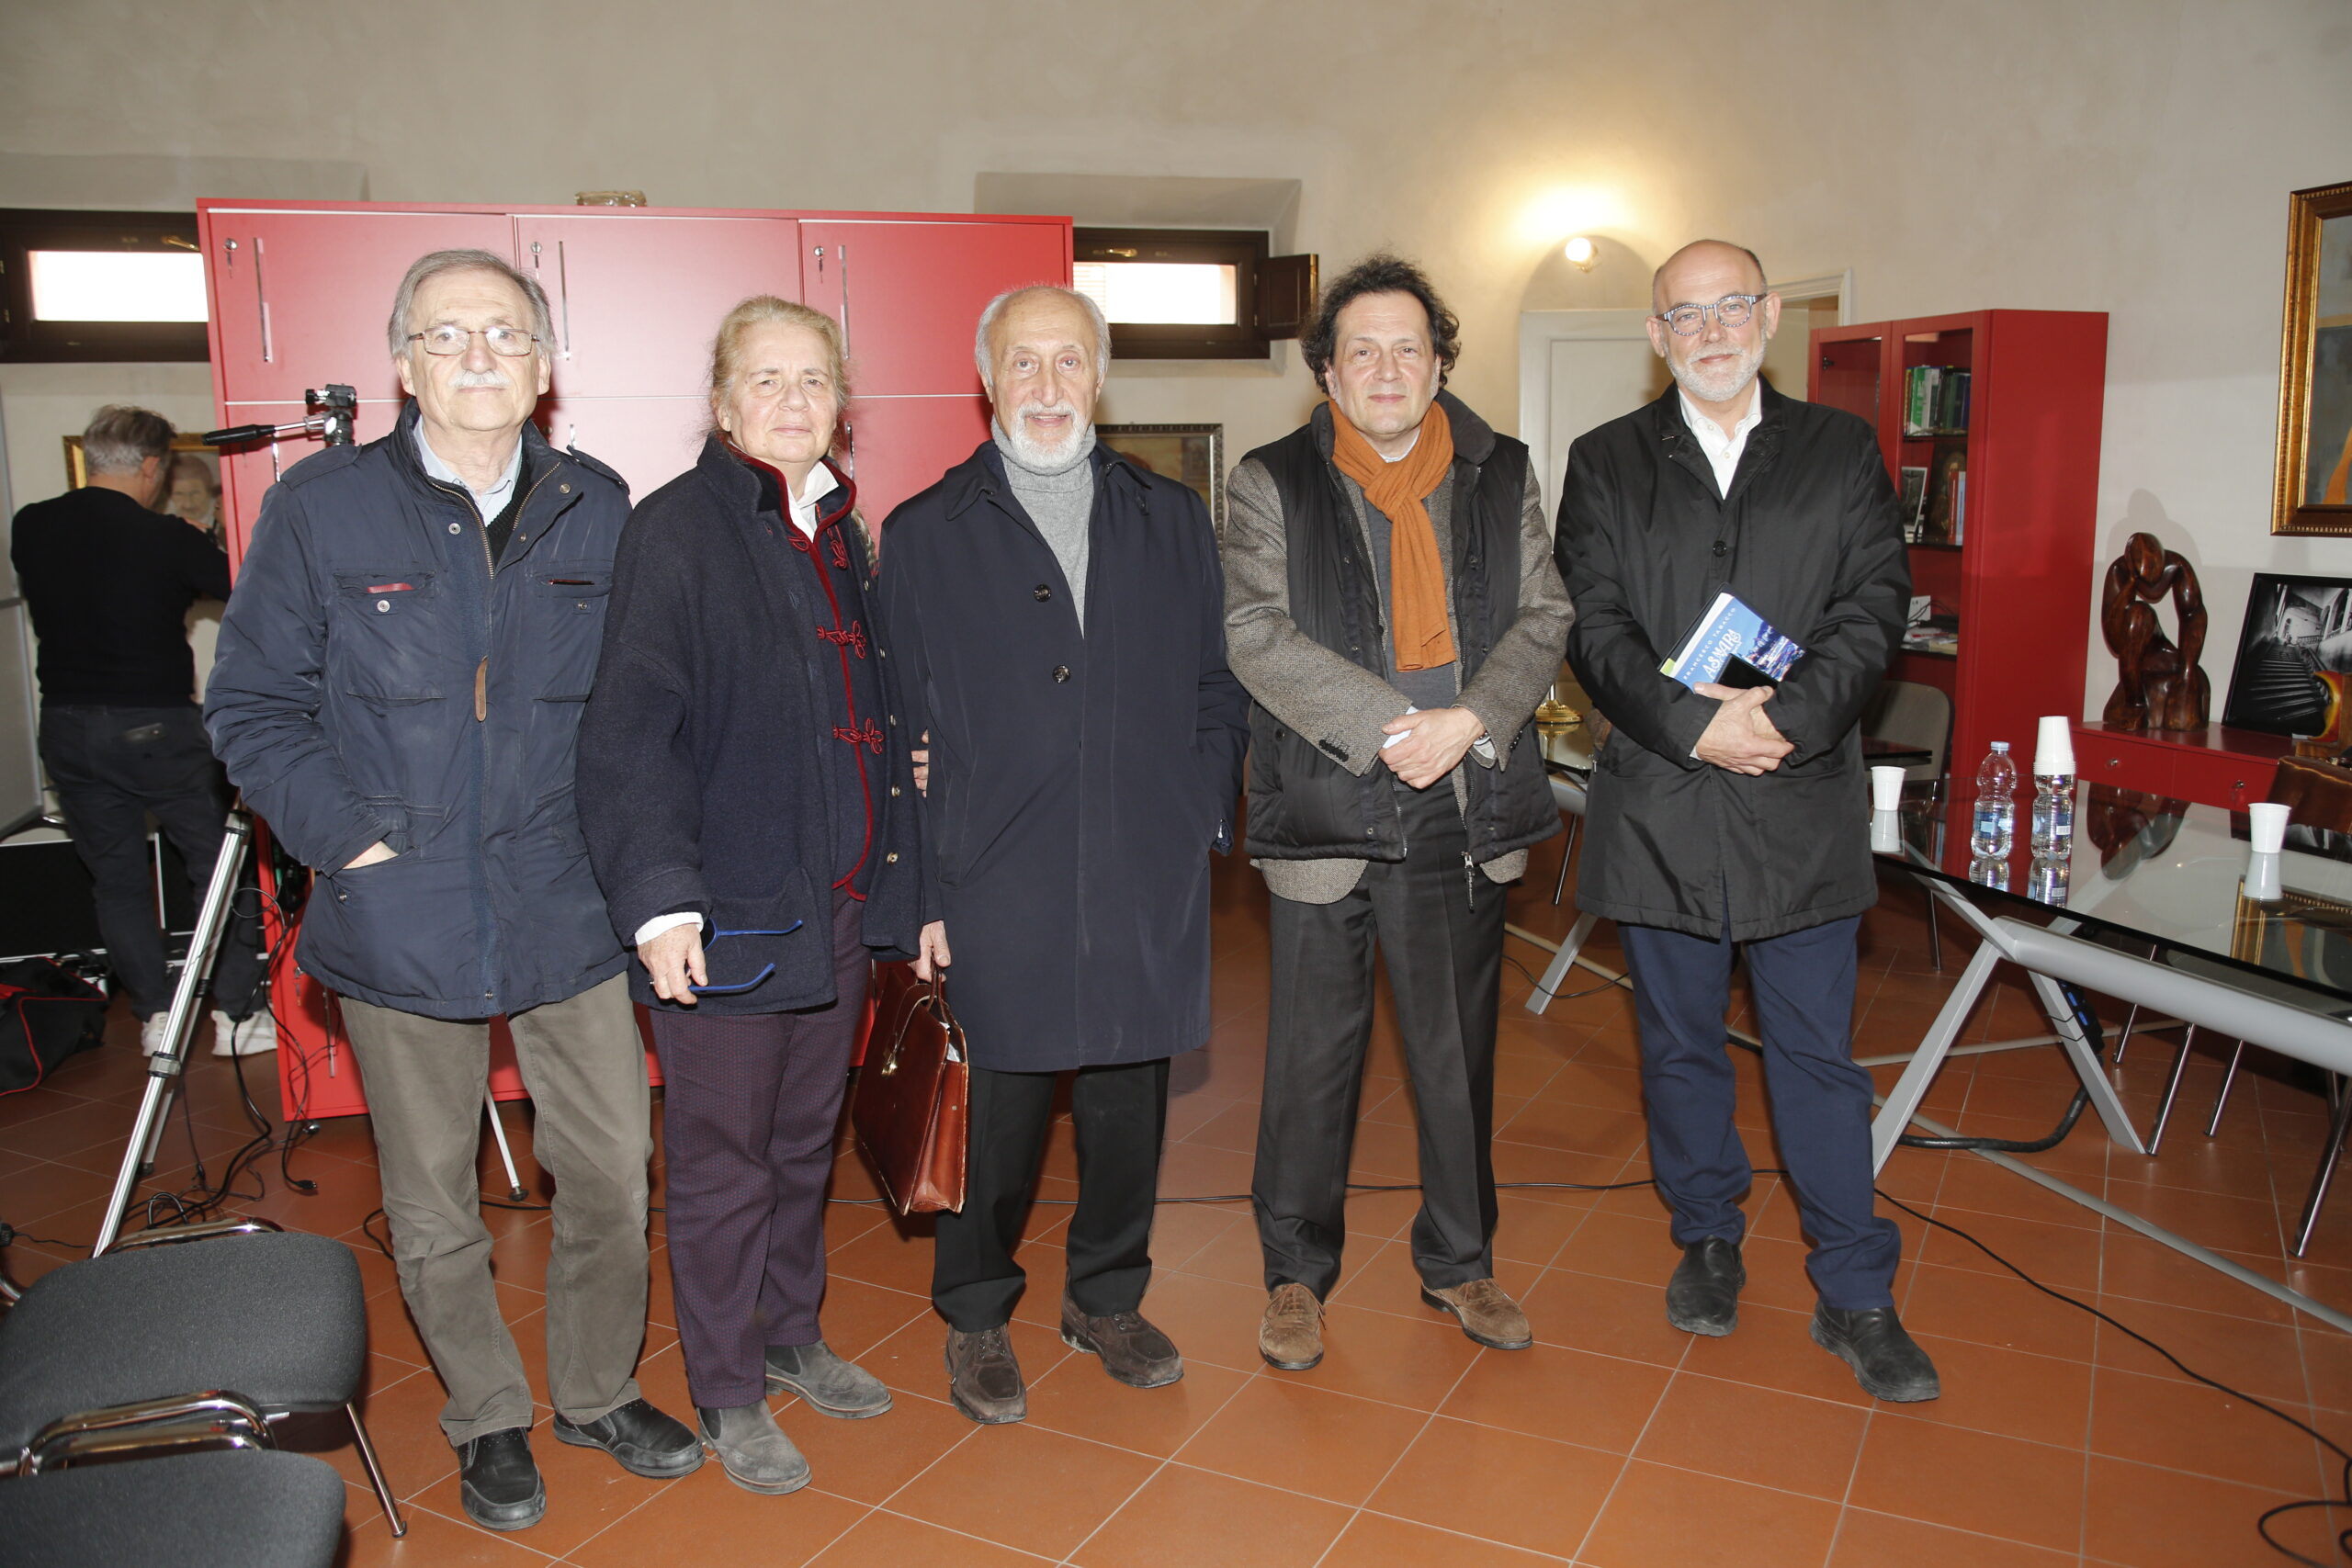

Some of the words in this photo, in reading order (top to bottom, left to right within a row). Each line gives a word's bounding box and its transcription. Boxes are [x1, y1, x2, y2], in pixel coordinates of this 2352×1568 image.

[1683, 640, 1713, 680] FRANCESCO
[1713, 607, 1736, 637] TABACCO
[1702, 628, 1742, 680] ASMARA
